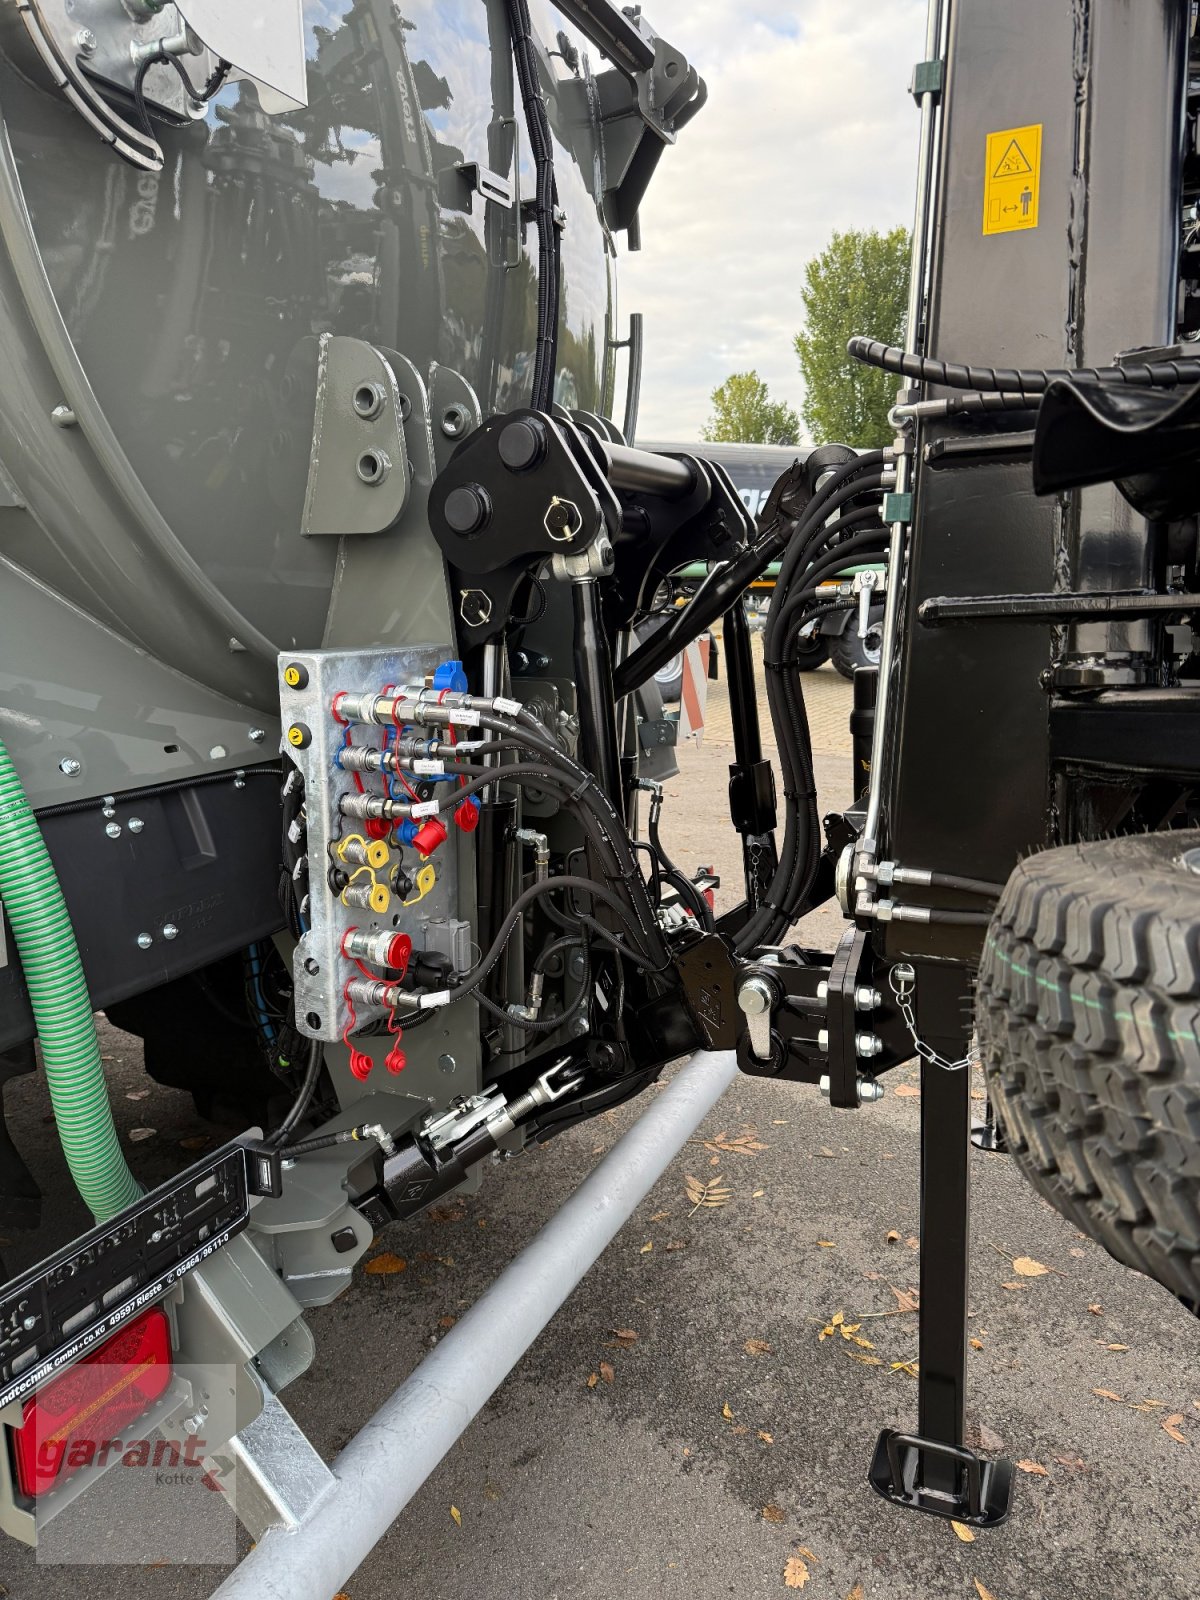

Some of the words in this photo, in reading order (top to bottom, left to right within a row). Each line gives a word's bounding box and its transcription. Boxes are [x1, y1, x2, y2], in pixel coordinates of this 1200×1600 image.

[0, 1361, 54, 1408] ndtechnik
[109, 1303, 135, 1325] 49597
[136, 1283, 162, 1307] Rieste
